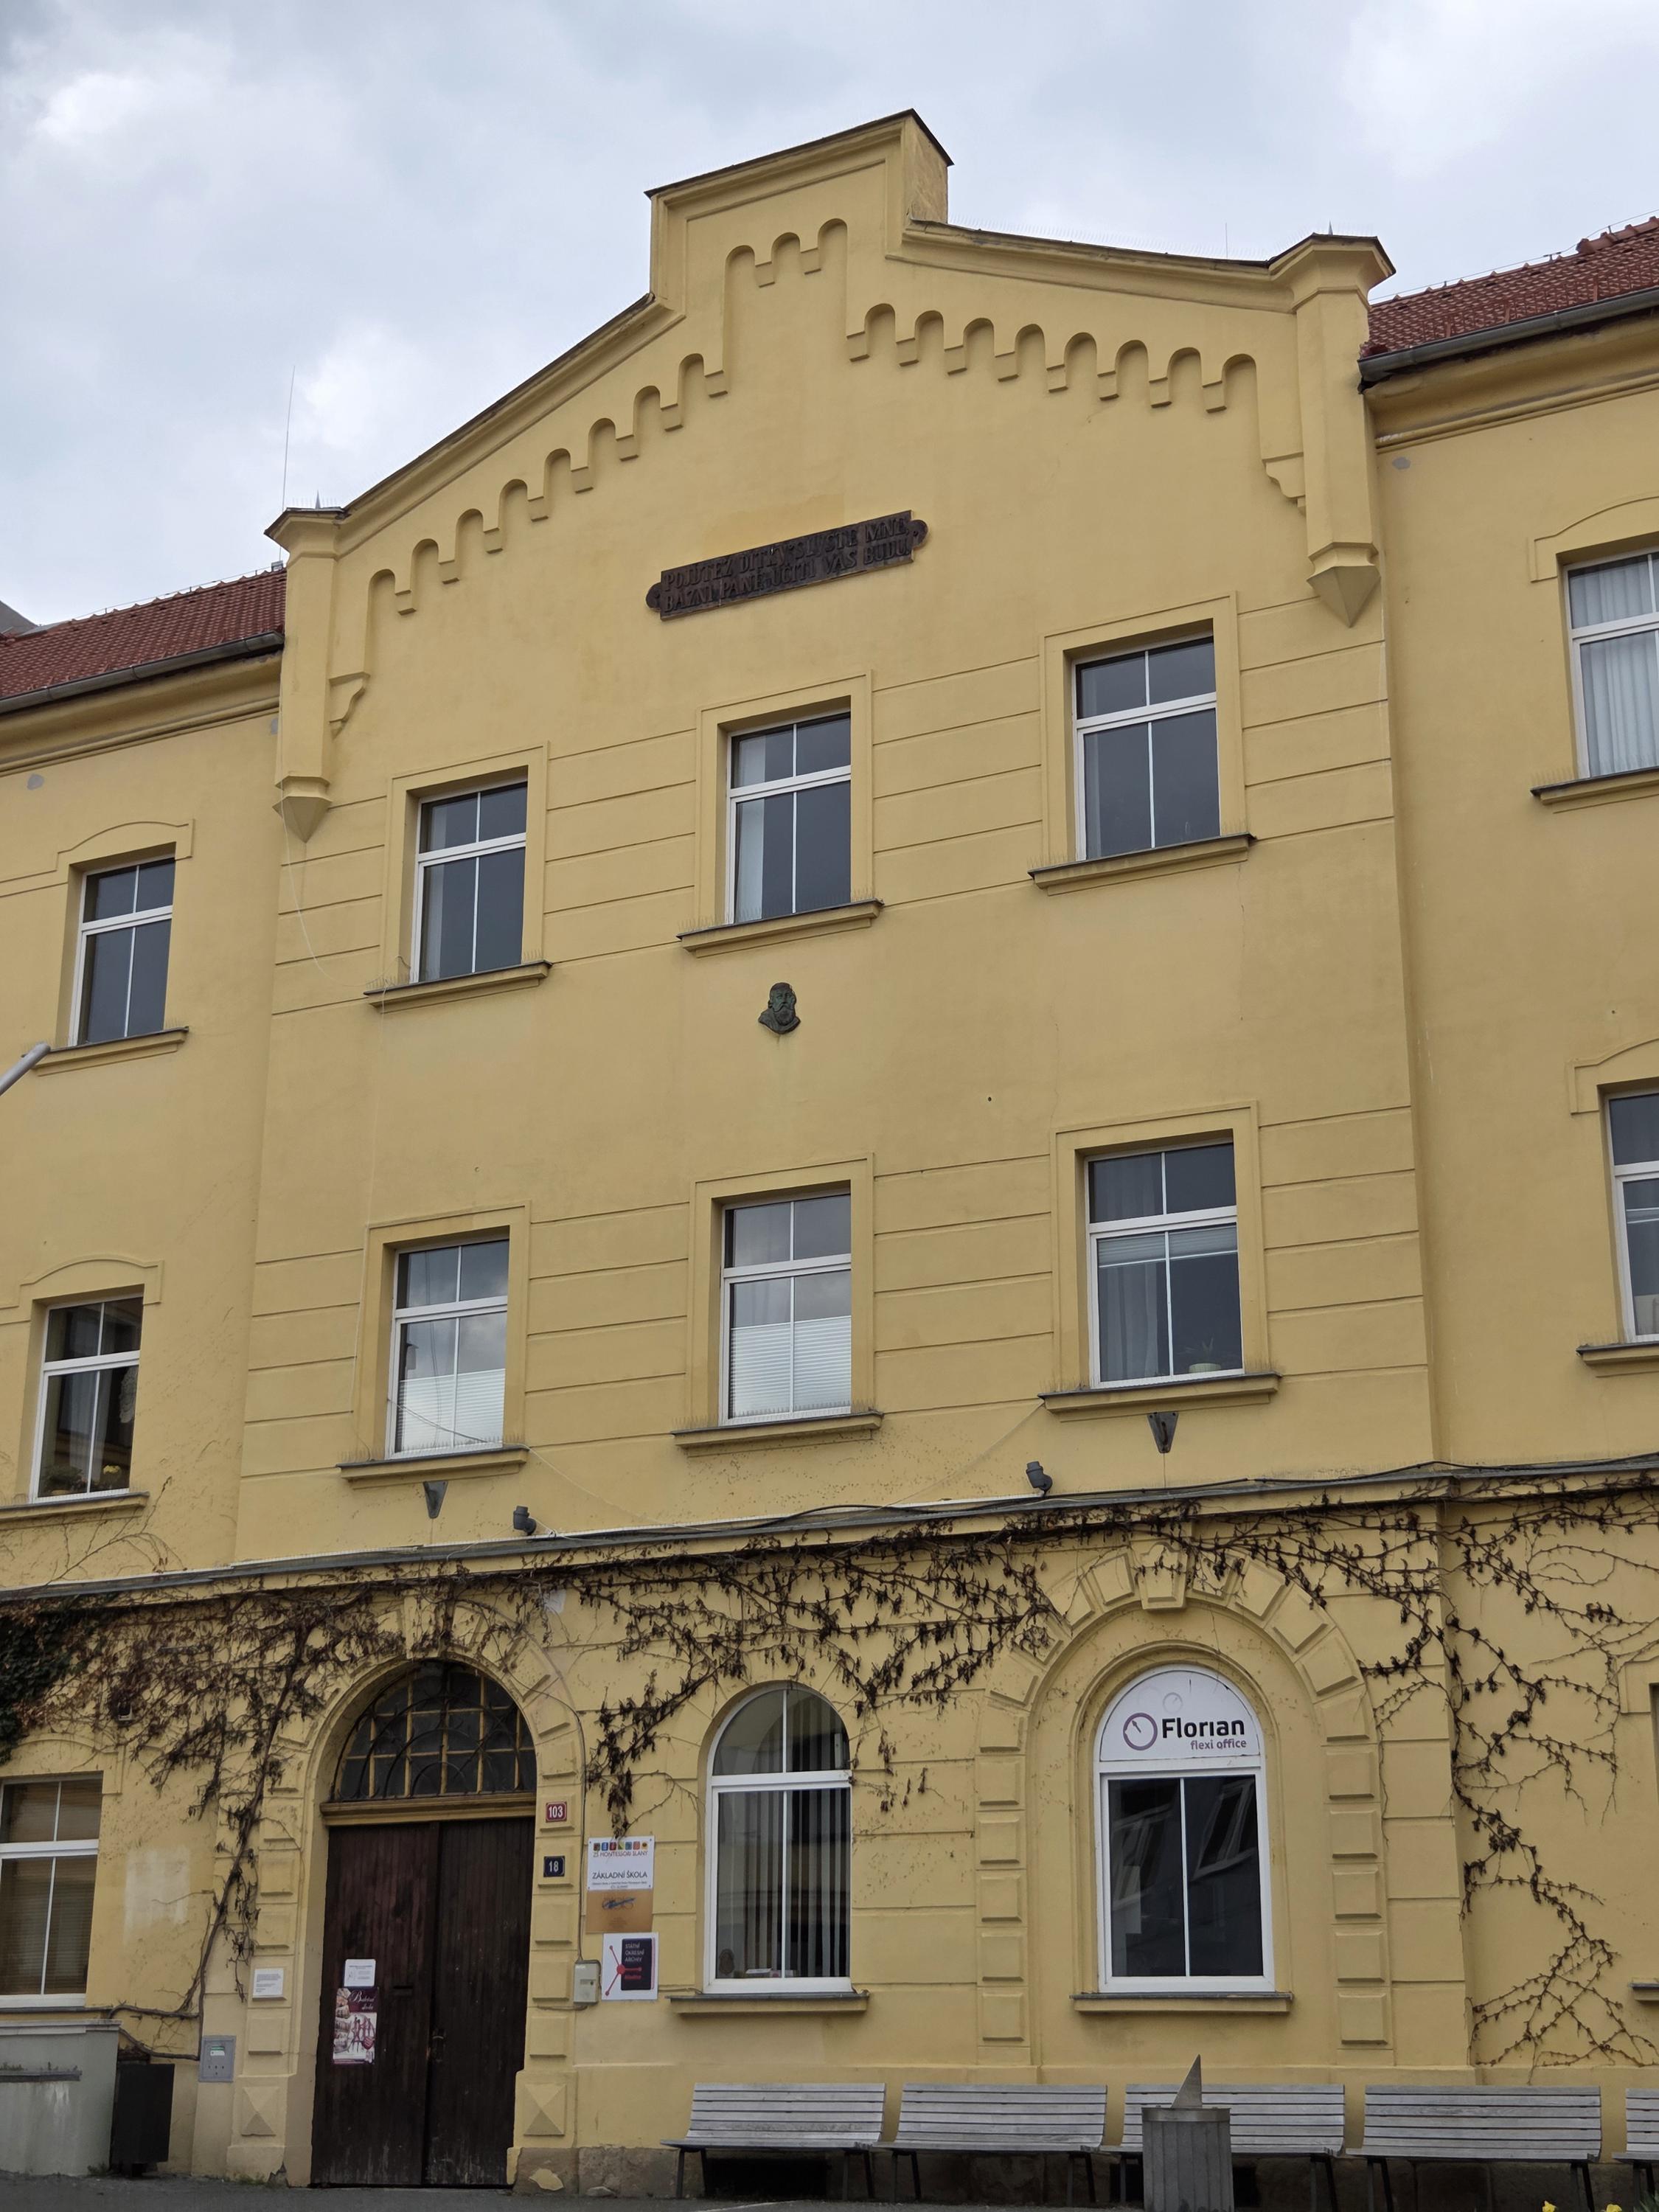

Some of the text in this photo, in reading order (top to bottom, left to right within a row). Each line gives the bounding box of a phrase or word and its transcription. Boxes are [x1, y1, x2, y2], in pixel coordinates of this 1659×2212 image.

[1162, 1717, 1245, 1739] Florian
[1190, 1738, 1247, 1750] flexi office
[549, 1806, 563, 1818] 103
[549, 1860, 559, 1872] 18
[592, 1870, 647, 1879] ZÁKLADNÍ ŠKOLA
